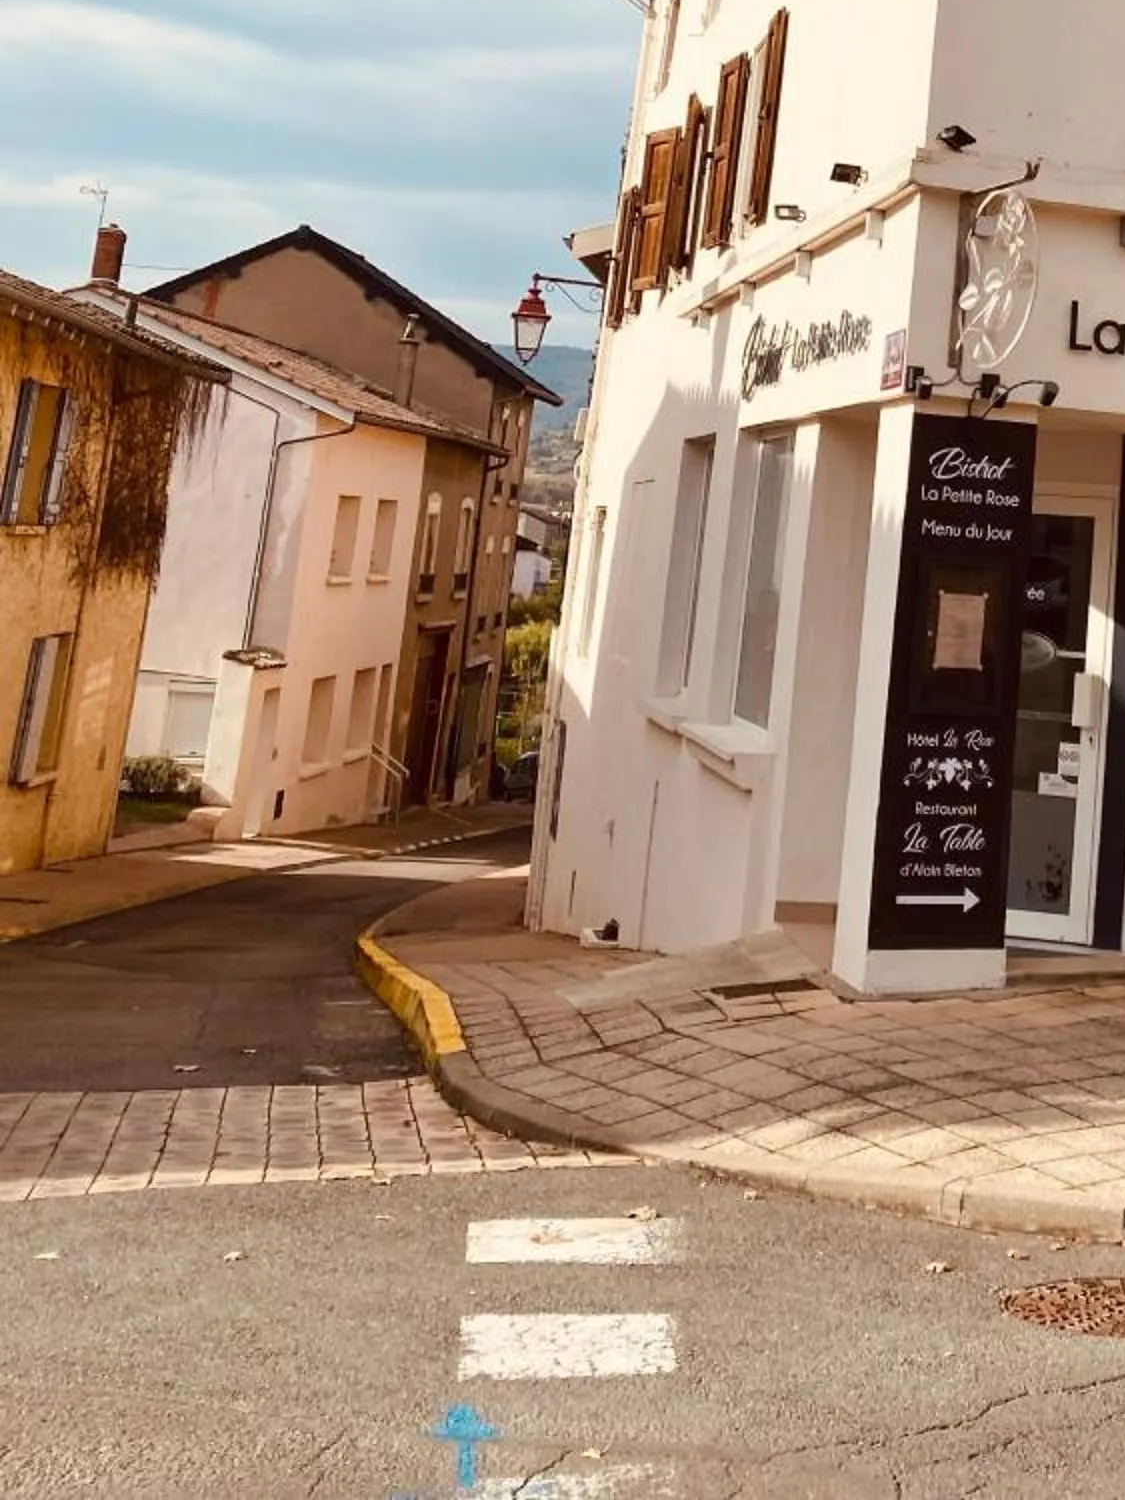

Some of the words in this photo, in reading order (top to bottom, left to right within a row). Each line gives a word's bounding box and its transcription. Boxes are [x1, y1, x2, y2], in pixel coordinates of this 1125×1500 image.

[928, 447, 1018, 480] Bistrot
[921, 483, 939, 501] La
[941, 485, 983, 505] Petite
[985, 488, 1020, 507] Rose
[921, 518, 961, 537] Menu
[965, 522, 983, 539] du
[985, 523, 1013, 541] Jour
[907, 731, 940, 748] Hôtel
[915, 801, 978, 816] Restaurant
[902, 821, 929, 854] La
[939, 822, 987, 853] Table
